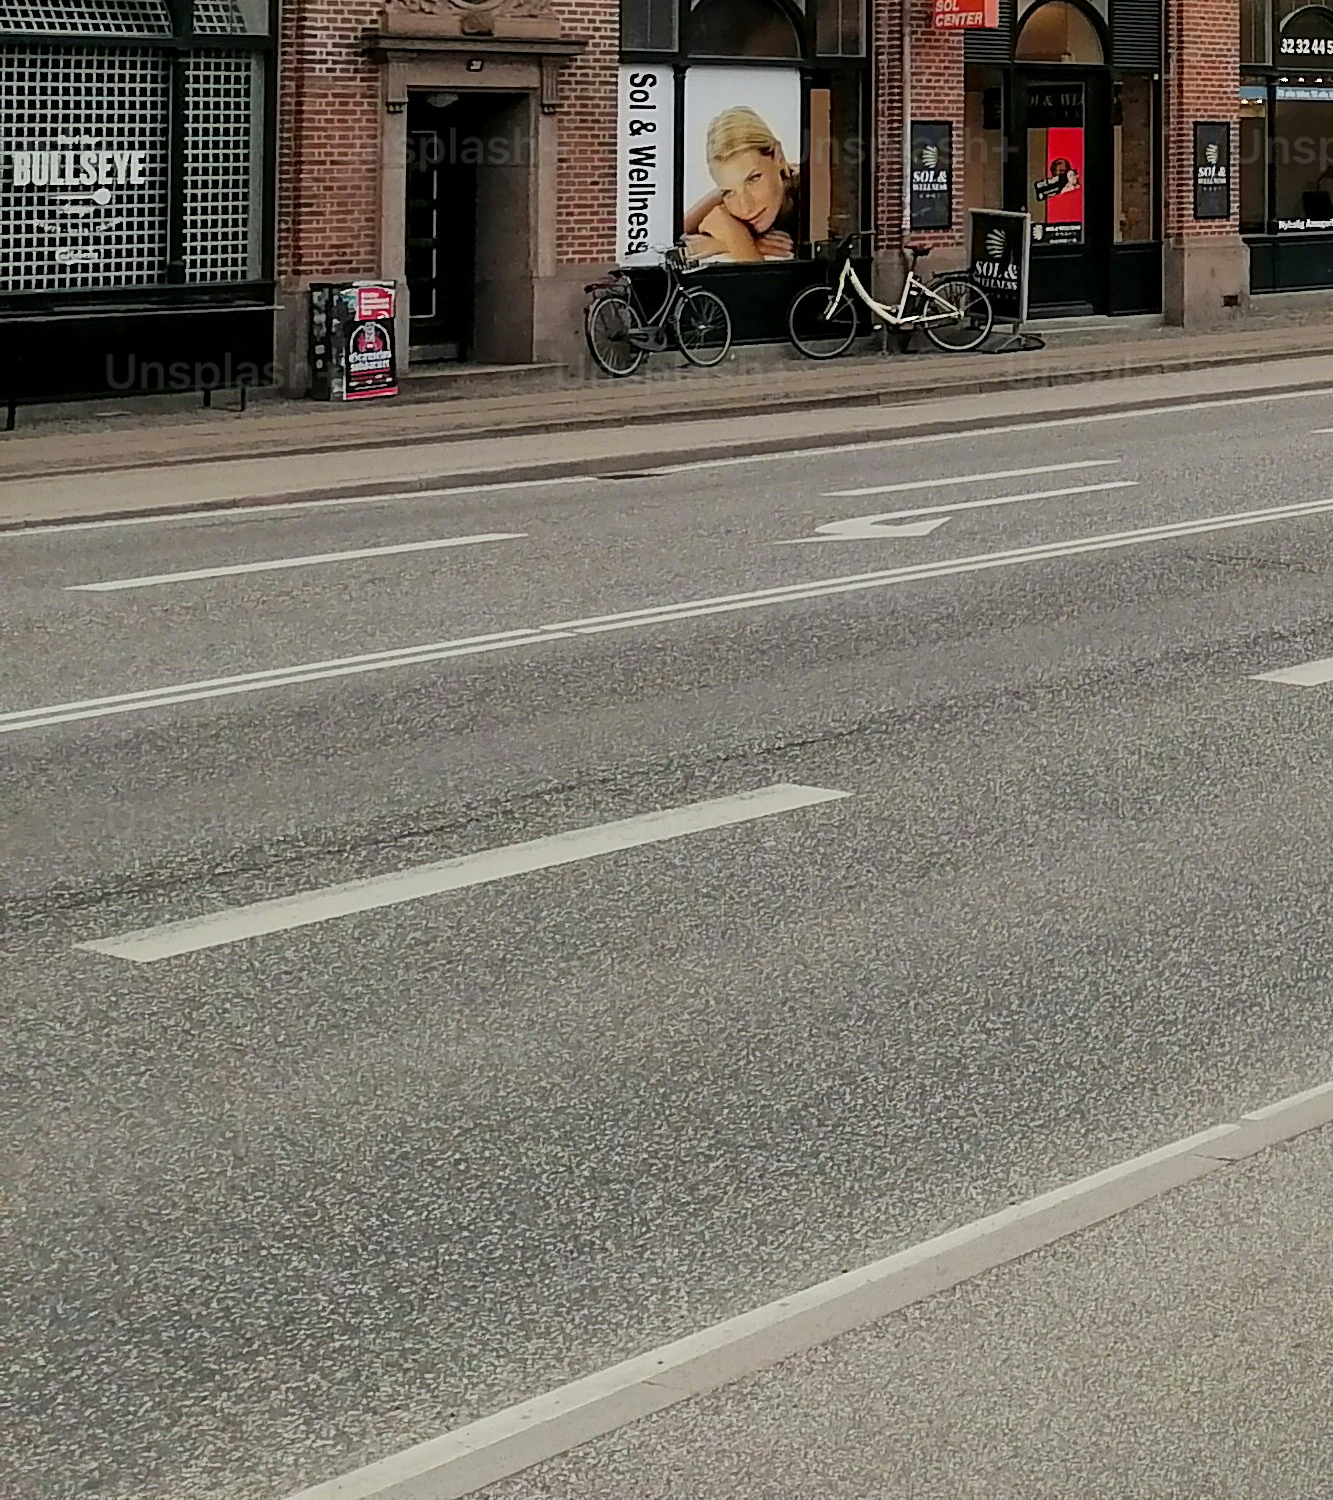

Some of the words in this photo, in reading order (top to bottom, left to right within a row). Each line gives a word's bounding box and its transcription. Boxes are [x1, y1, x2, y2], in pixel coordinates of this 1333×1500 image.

[935, 0, 960, 12] SOL
[935, 11, 982, 28] CENTER
[1280, 38, 1295, 54] 32
[1296, 38, 1310, 54] 32
[1311, 39, 1325, 54] 44
[628, 73, 657, 109] Sol
[628, 119, 657, 137] &
[12, 151, 146, 186] BULLSEYE
[975, 260, 1002, 278] SOL
